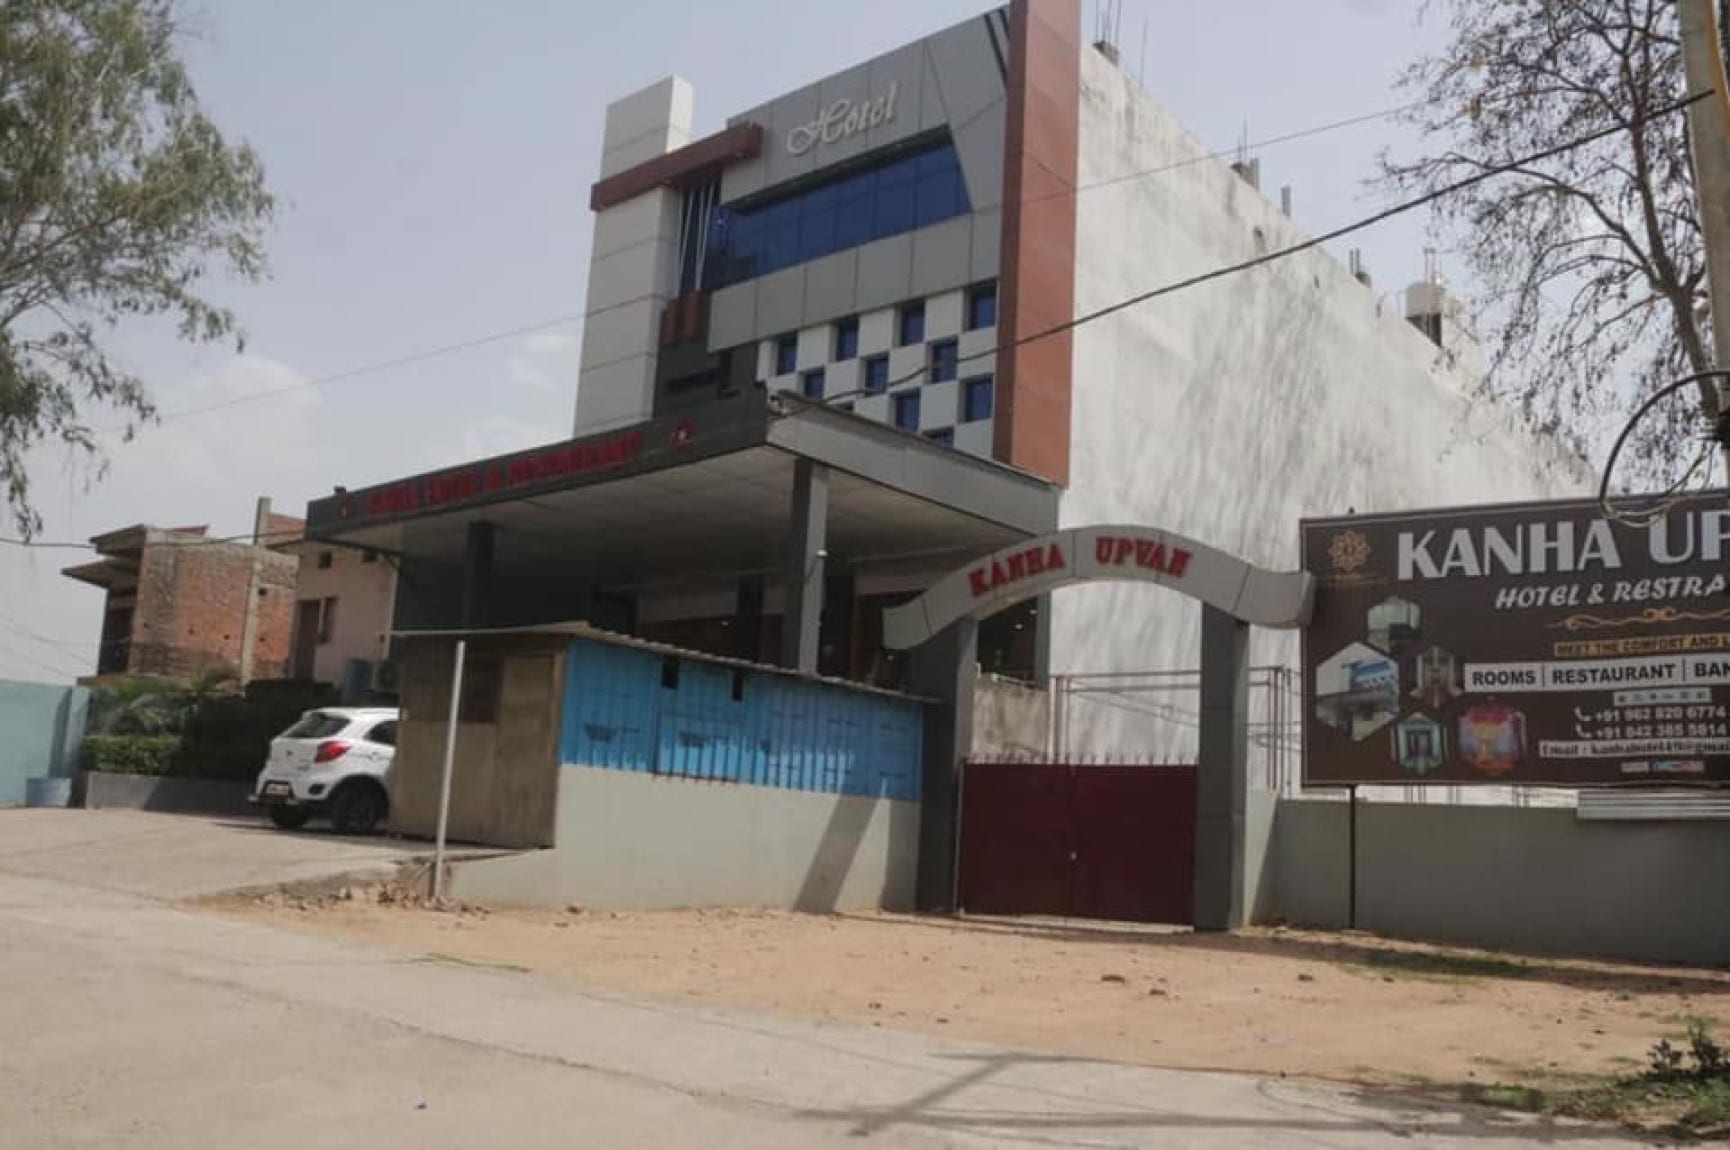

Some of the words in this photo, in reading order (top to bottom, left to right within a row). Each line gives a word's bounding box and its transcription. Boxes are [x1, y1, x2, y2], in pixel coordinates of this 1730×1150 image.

[787, 80, 899, 156] Hotel
[968, 543, 1066, 597] KANHA
[1095, 536, 1193, 578] UPVAN
[1398, 519, 1622, 580] KANHA
[1495, 583, 1580, 609] HOTEL
[1587, 583, 1604, 605] &
[1472, 670, 1536, 686] ROOMS
[1552, 664, 1675, 684] RESTAURANT
